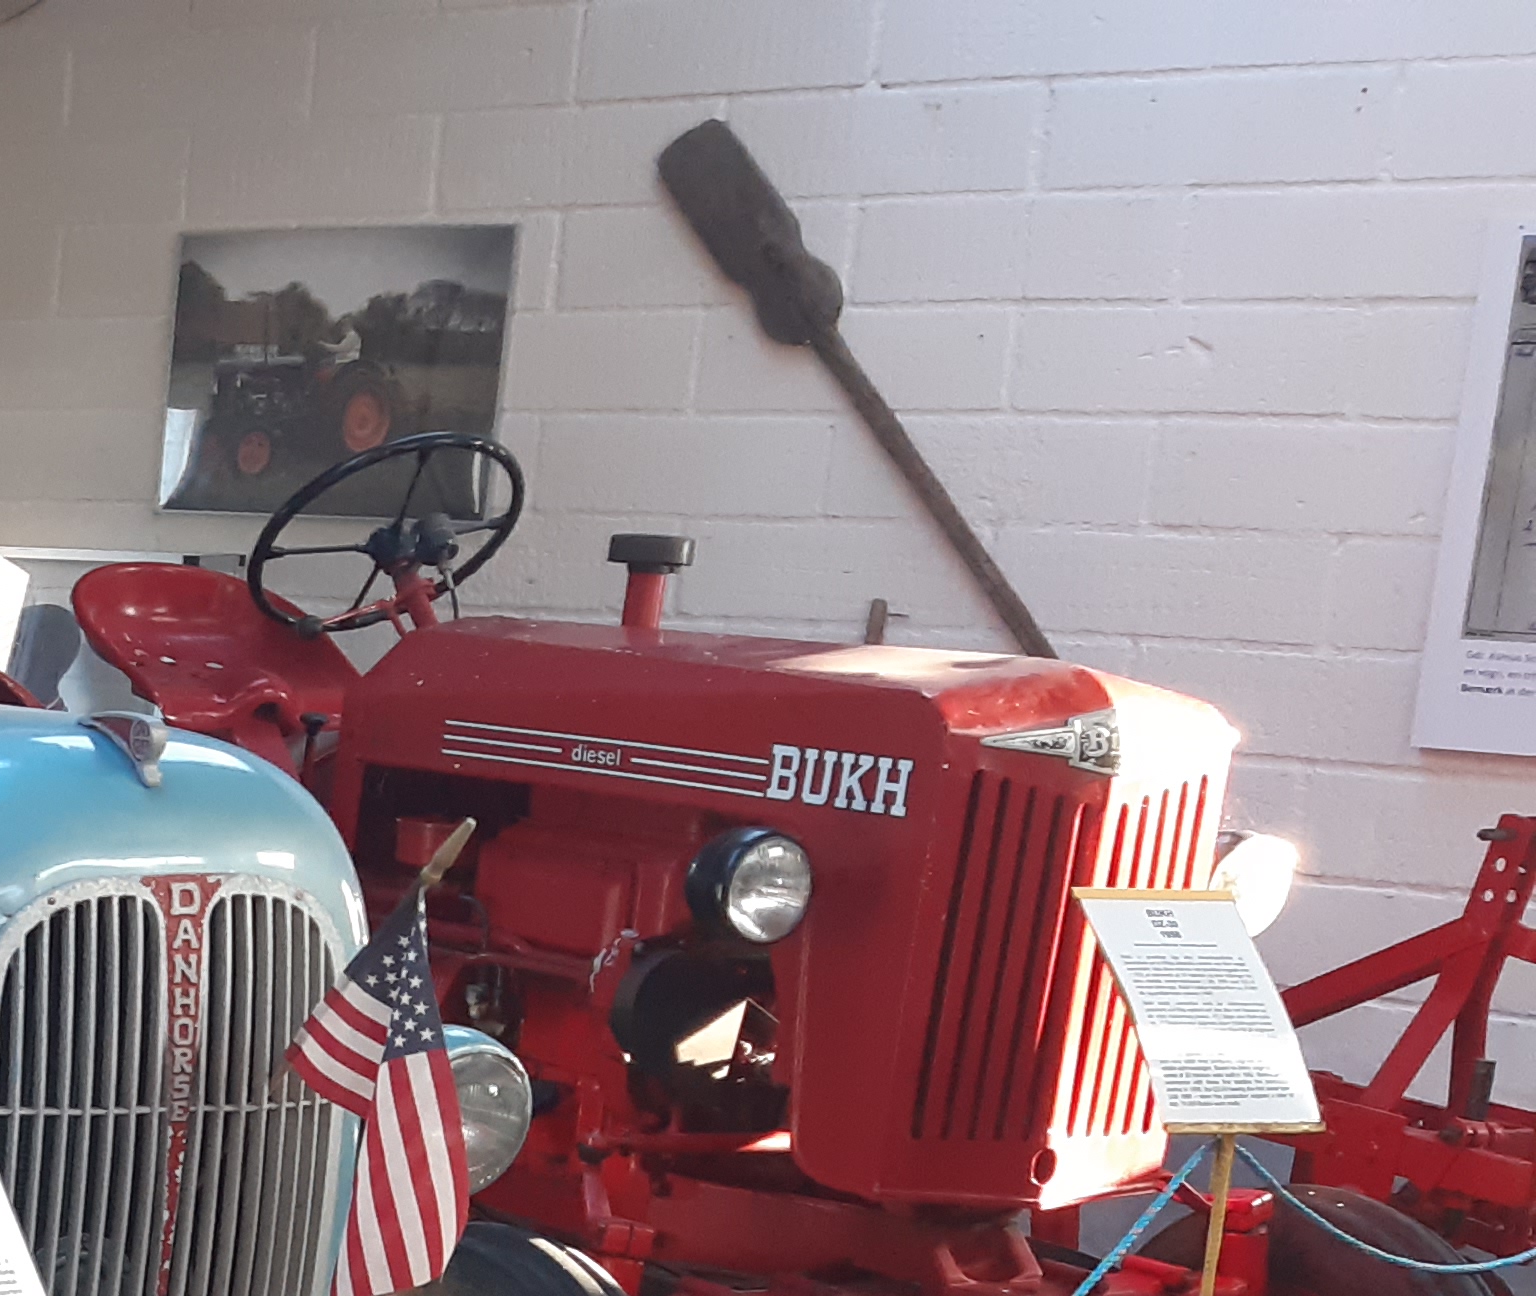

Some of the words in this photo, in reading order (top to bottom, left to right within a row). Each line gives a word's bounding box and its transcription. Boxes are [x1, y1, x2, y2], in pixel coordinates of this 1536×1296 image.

[571, 743, 621, 766] diesel
[766, 743, 914, 818] BUKH
[169, 881, 202, 1122] DANHORSE
